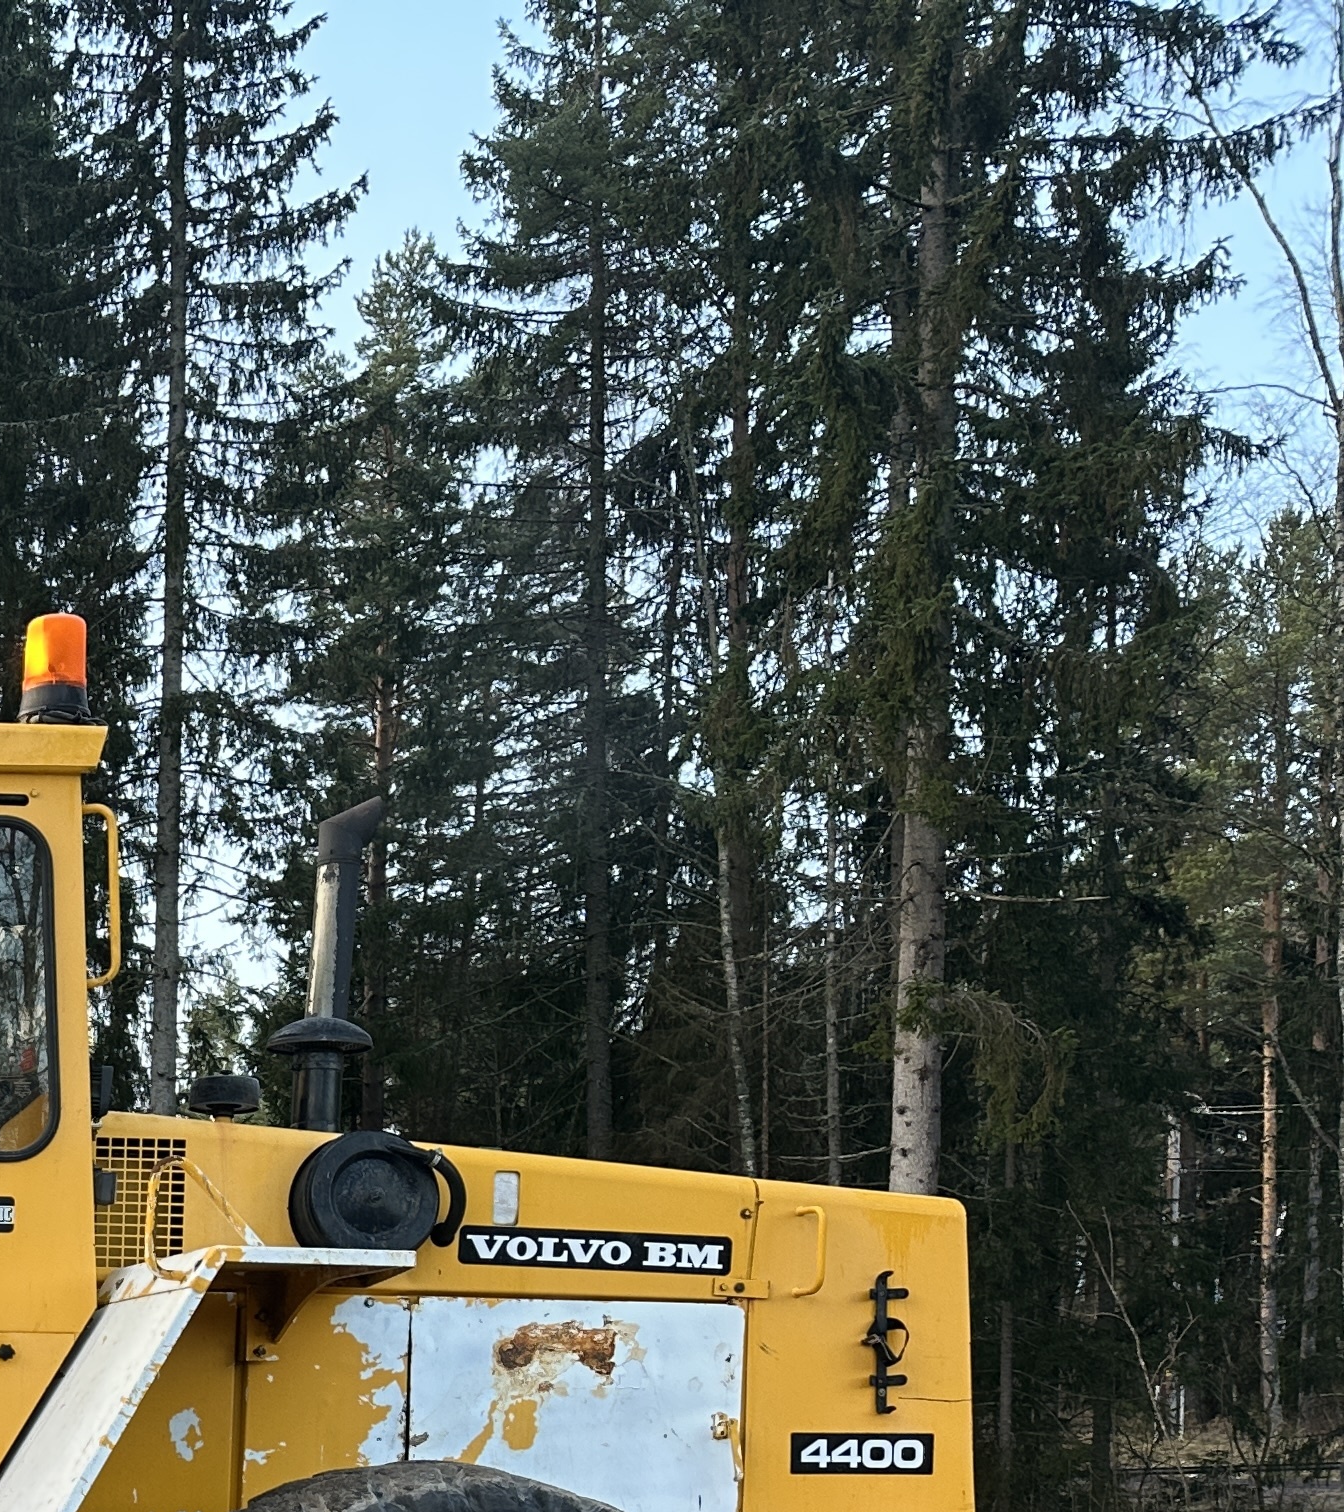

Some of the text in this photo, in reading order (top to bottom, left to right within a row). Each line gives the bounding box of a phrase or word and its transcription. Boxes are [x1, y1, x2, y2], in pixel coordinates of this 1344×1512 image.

[466, 1234, 725, 1270] VOLVO BM
[800, 1438, 924, 1469] 4400
